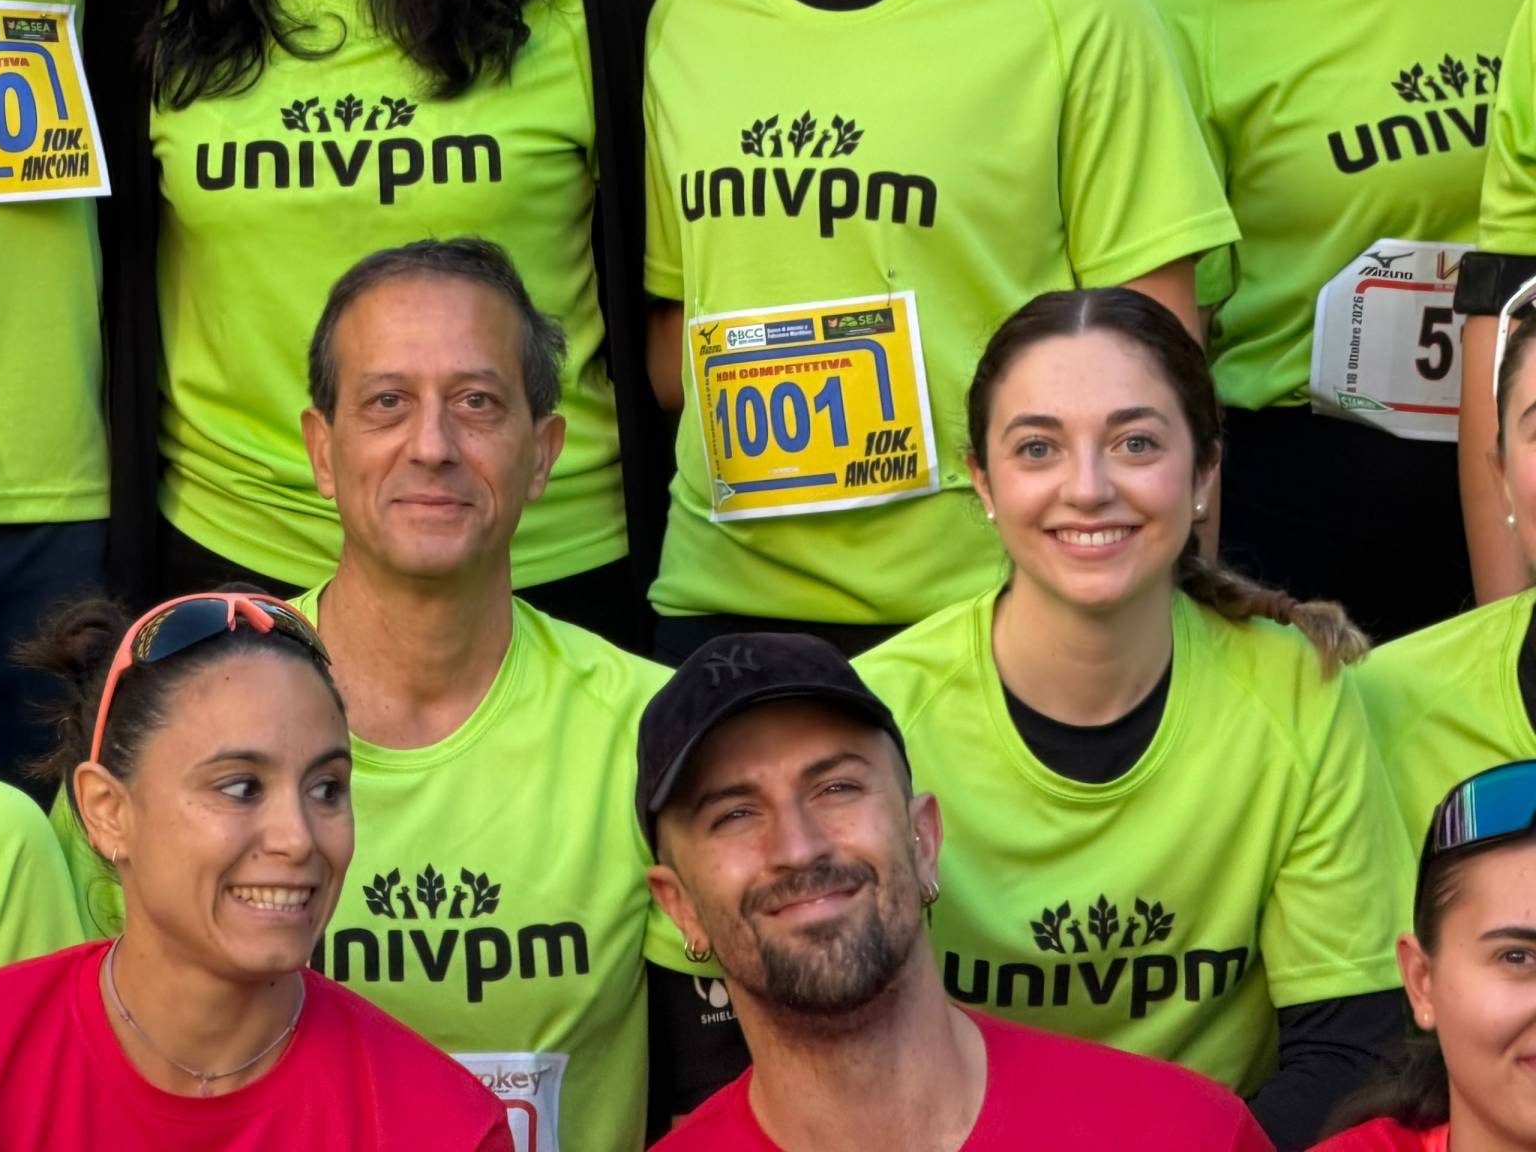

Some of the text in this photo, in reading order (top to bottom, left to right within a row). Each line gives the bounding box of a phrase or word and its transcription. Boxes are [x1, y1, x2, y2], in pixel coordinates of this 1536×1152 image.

[31, 22, 51, 32] SEA
[41, 127, 84, 152] 10K
[20, 151, 90, 183] ANCONA
[195, 134, 503, 206] univpm
[680, 165, 938, 238] univpm
[1358, 266, 1414, 280] MIZUNO
[858, 313, 884, 326] SEA
[1352, 295, 1364, 325] 2026
[737, 328, 763, 339] BCC
[1415, 306, 1464, 382] 5
[716, 358, 853, 382] NON COMPETITIVA
[715, 376, 849, 460] 1001
[865, 426, 913, 457] 10K
[845, 452, 918, 488] ANCONA
[943, 946, 1249, 1019] univpm
[700, 1010, 737, 1025] SHIEL
